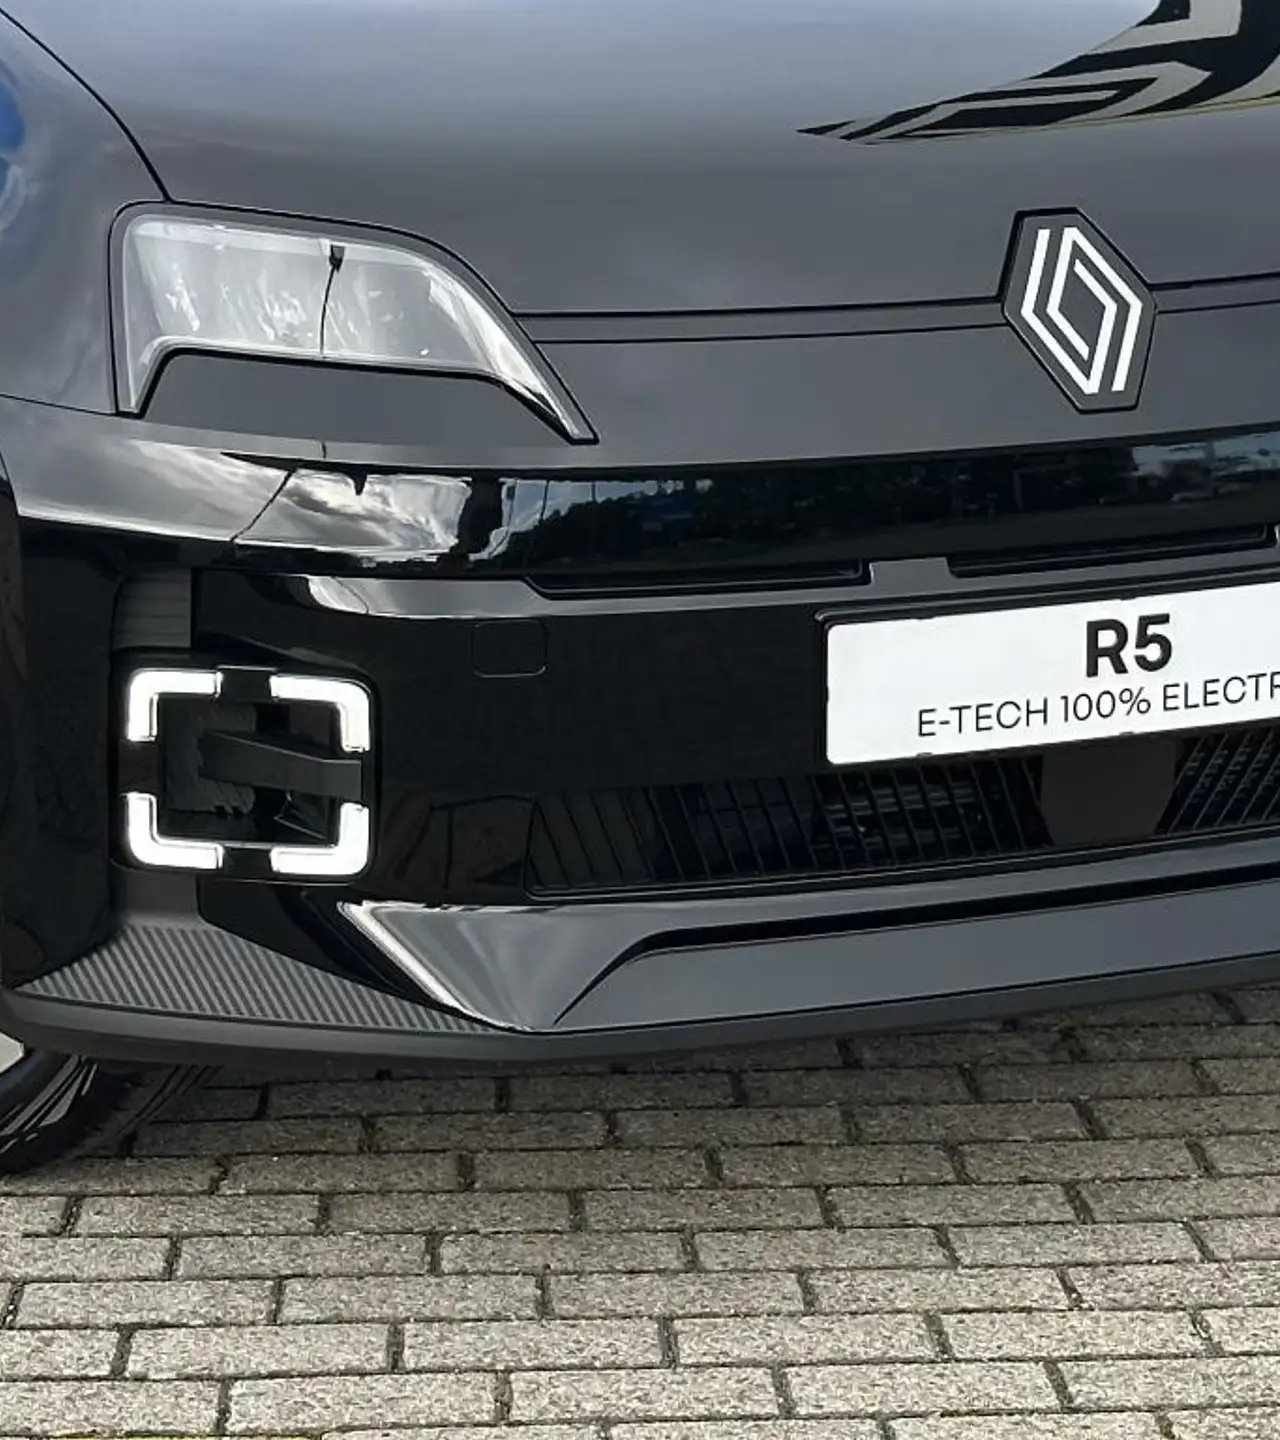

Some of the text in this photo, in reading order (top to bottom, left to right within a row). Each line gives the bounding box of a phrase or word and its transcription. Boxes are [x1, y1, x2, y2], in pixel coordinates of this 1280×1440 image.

[1085, 613, 1173, 678] R5
[918, 696, 1049, 738] E-TECH
[1061, 686, 1152, 722] 100%
